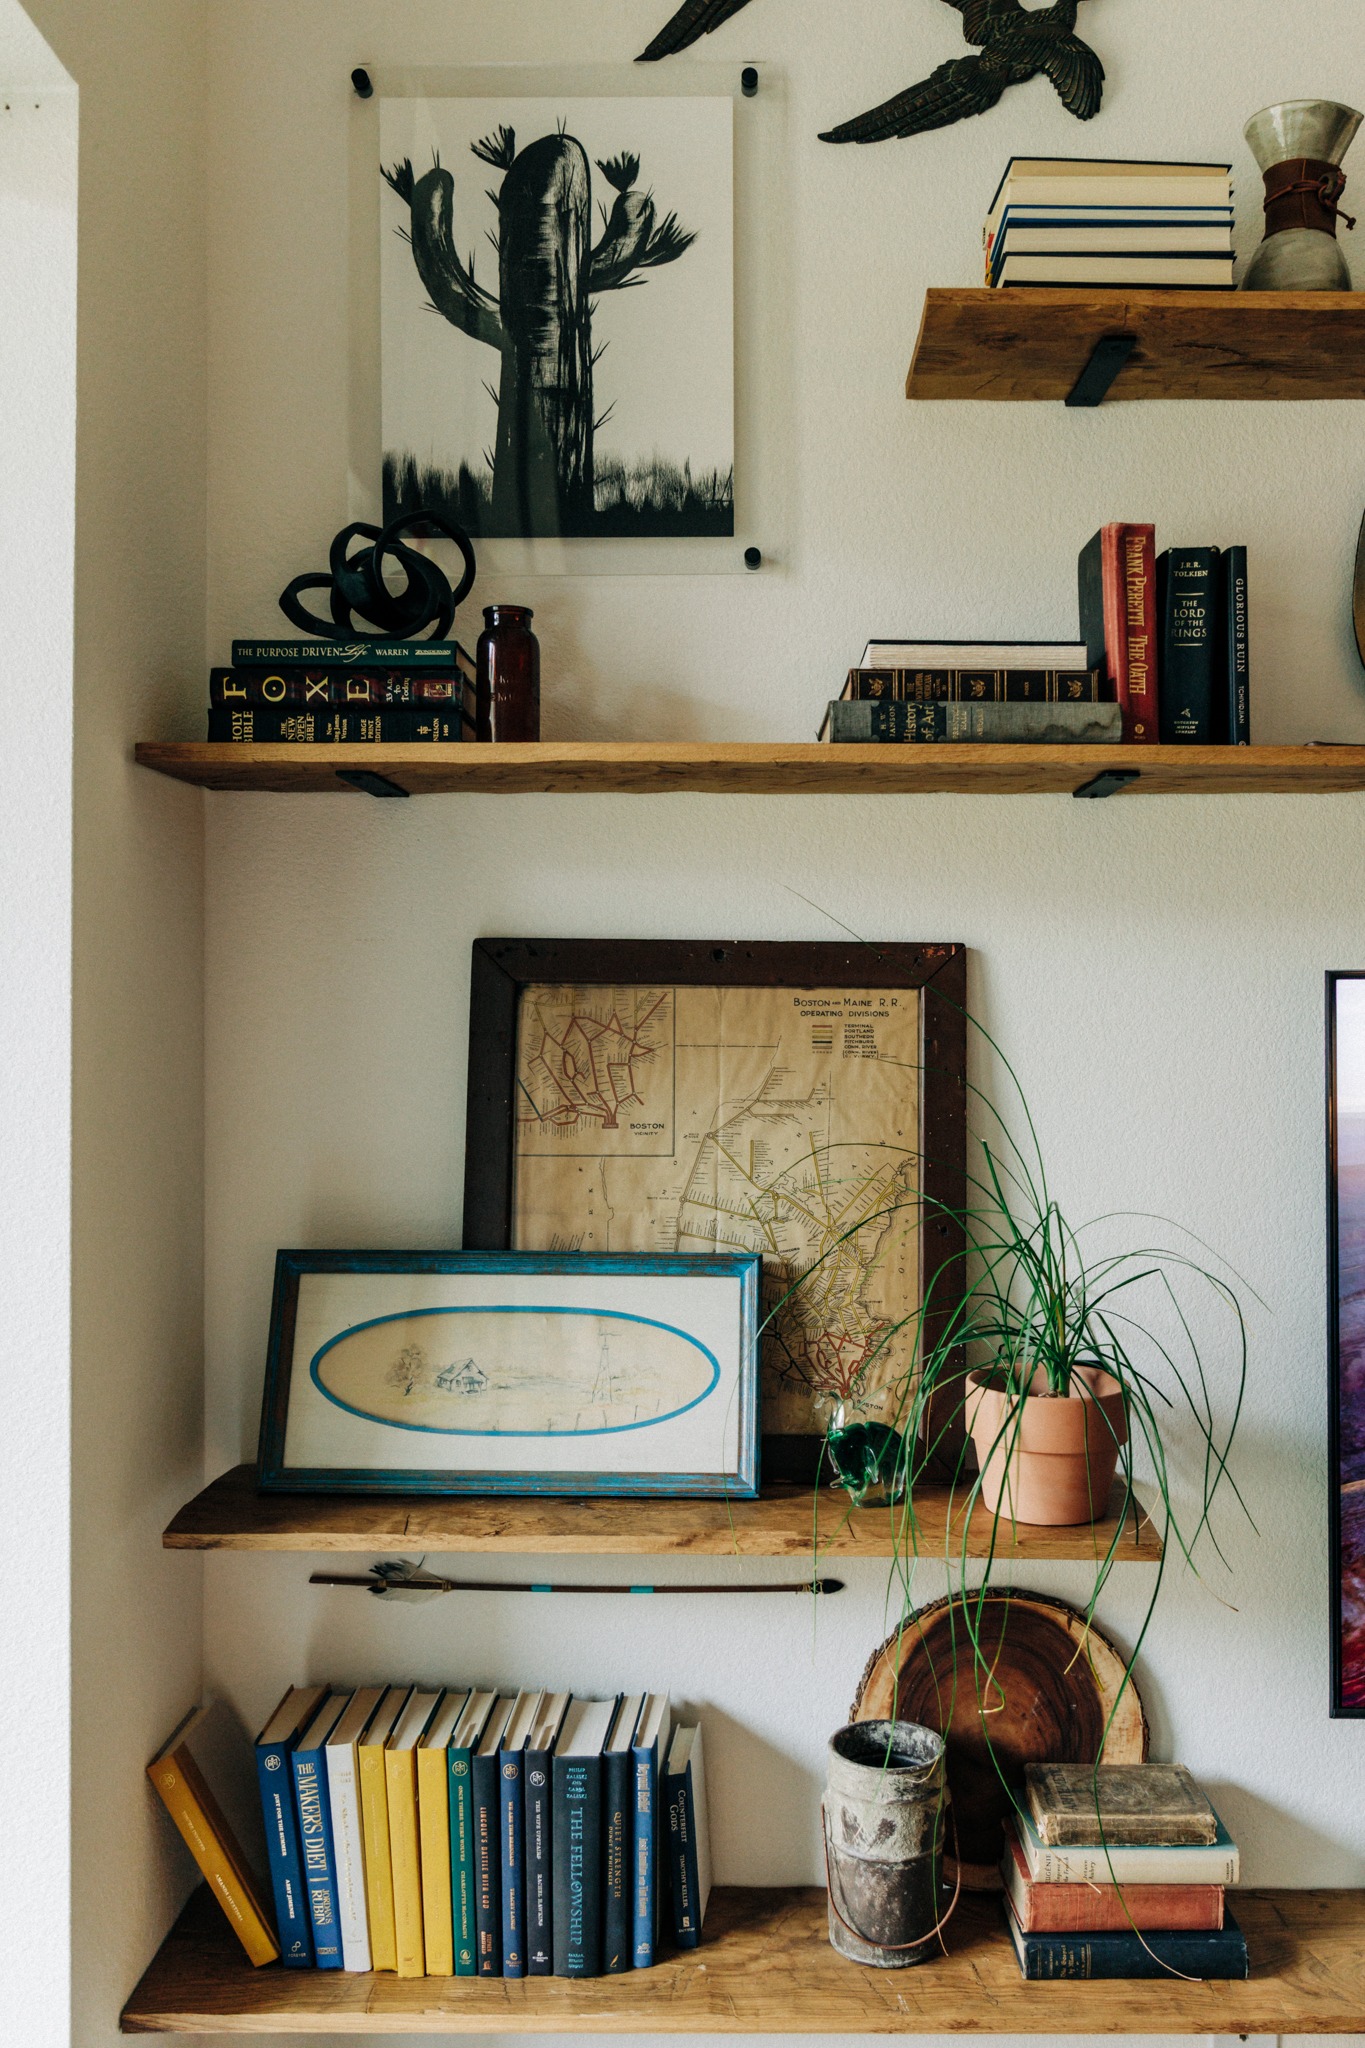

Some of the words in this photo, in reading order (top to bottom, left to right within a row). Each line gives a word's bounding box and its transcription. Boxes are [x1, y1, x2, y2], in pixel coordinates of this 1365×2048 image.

[1126, 536, 1147, 575] FRANK
[1181, 561, 1201, 569] J.R.R.
[1173, 570, 1209, 578] TOLKIEN
[1127, 576, 1148, 626] PERETTI
[1173, 608, 1206, 618] LORD
[1235, 578, 1245, 638] GLORIOUS
[1171, 628, 1208, 638] RINGS
[237, 648, 253, 656] THE
[256, 647, 299, 657] PURPOSE
[302, 647, 341, 657] DRIVEN
[340, 643, 372, 663] Life
[375, 649, 410, 657] WARREN
[1128, 635, 1148, 660] THE
[1236, 643, 1246, 672] RUIN
[393, 684, 401, 695] to
[401, 677, 411, 702] Today
[1128, 662, 1149, 695] OATH
[386, 692, 394, 702] 33
[232, 711, 242, 742] HOLY
[243, 711, 254, 742] BIBLE
[904, 702, 923, 743] History
[922, 705, 935, 726] Art
[288, 717, 296, 740] NEW
[297, 715, 305, 742] OPEN
[921, 727, 934, 742] of
[793, 997, 831, 1007] BOSTON
[843, 997, 873, 1007] MAINE
[800, 1010, 843, 1018] OPERATING
[848, 1010, 890, 1018] DIVISIONS
[297, 1763, 315, 1774] THE
[637, 1763, 650, 1791] Beyond
[297, 1775, 323, 1835] MAKER'S
[508, 1801, 514, 1811] WE
[637, 1791, 650, 1813] Belief
[479, 1806, 488, 1844] LINCOLN'S
[570, 1807, 583, 1840] THE
[613, 1811, 622, 1842] QUIET
[669, 1804, 680, 1832] GODS
[677, 1789, 688, 1843] COUNTERFEIT
[279, 1832, 287, 1857] SUMMER
[305, 1837, 328, 1872] DIET
[481, 1846, 489, 1871] BATTLE
[679, 1854, 687, 1884] TIMOTHY
[1088, 1861, 1096, 1880] Aubry
[481, 1874, 489, 1892] WITH
[613, 1846, 622, 1898] STRENGTH
[286, 1895, 295, 1919] JIMENEZ
[322, 1888, 331, 1917] JORDAN
[482, 1894, 490, 1909] GOD
[570, 1844, 583, 1945] FELLOWSHIP
[681, 1884, 689, 1908] KELLER
[311, 1889, 326, 1926] RUBIN
